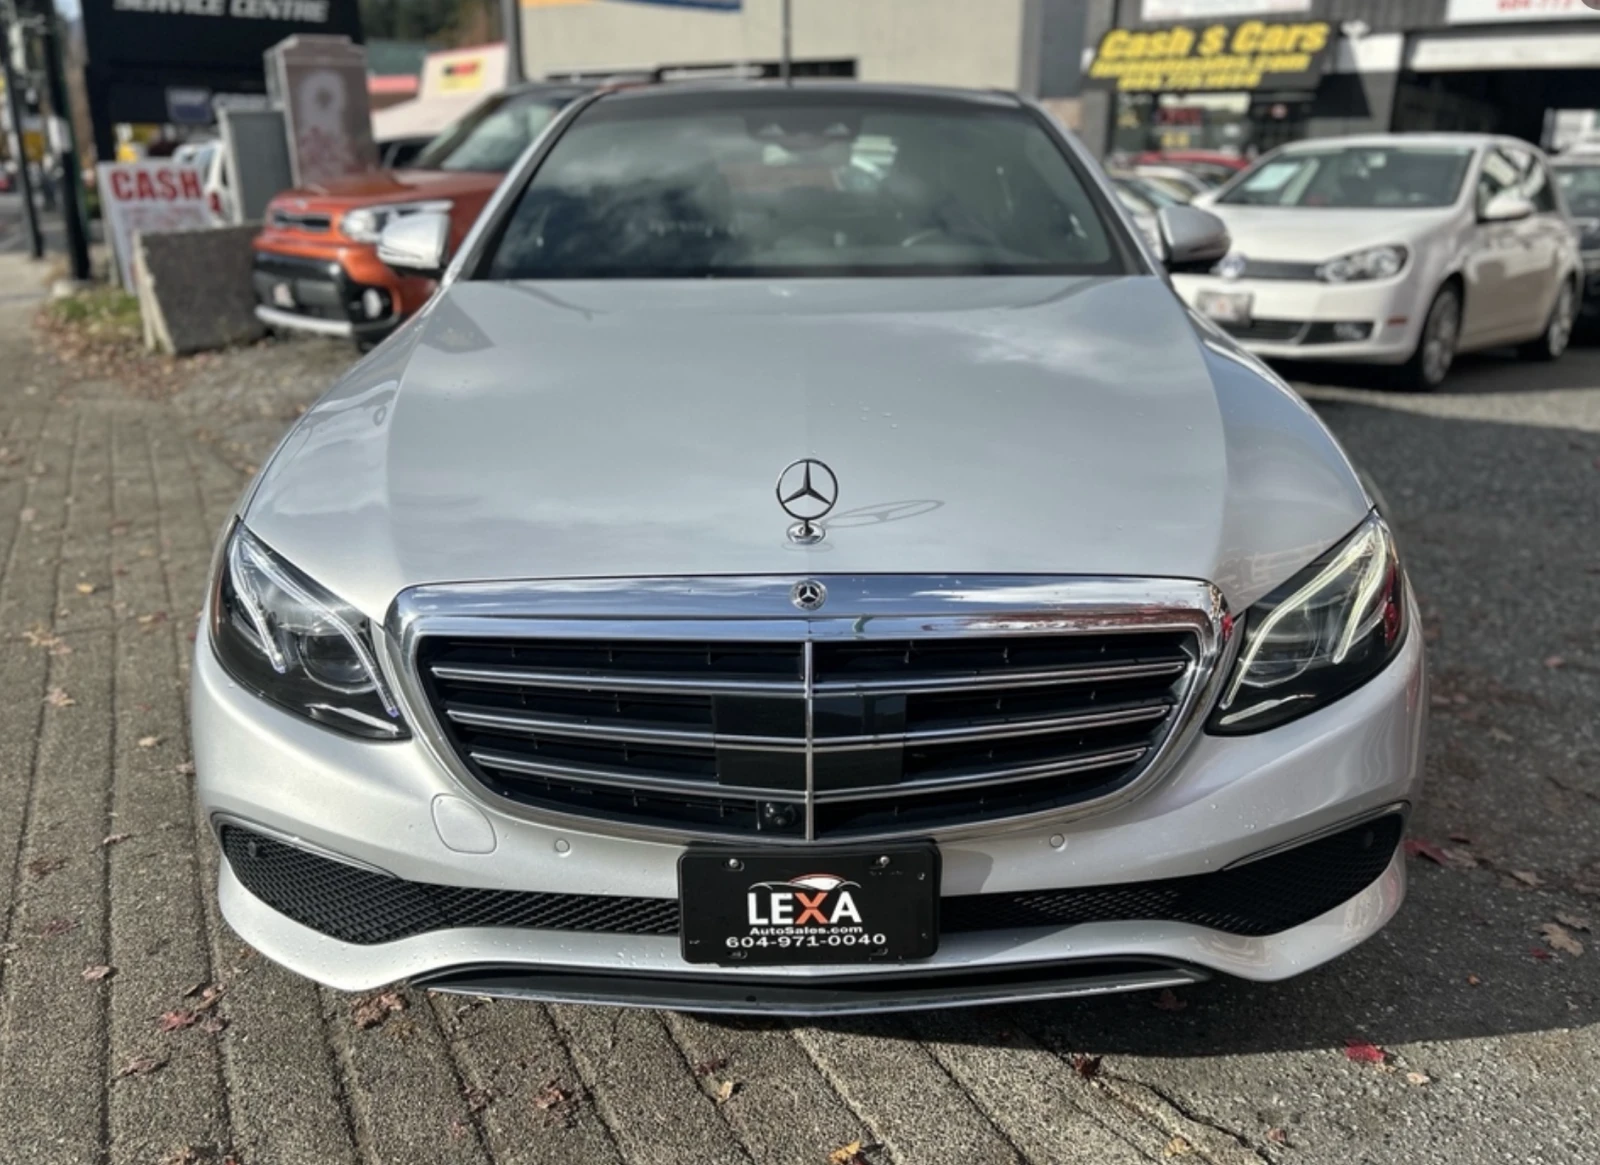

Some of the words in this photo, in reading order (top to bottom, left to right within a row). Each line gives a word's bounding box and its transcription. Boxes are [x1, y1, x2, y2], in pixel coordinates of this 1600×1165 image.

[112, 0, 225, 16] SERVICE
[229, 0, 328, 22] CENTRE
[1101, 26, 1194, 57] Cash
[1231, 20, 1330, 53] Cars
[110, 168, 203, 202] CASH
[747, 891, 862, 925] LEXA
[725, 933, 886, 948] 604-971-0040
[750, 926, 863, 935] AutoSales.com
